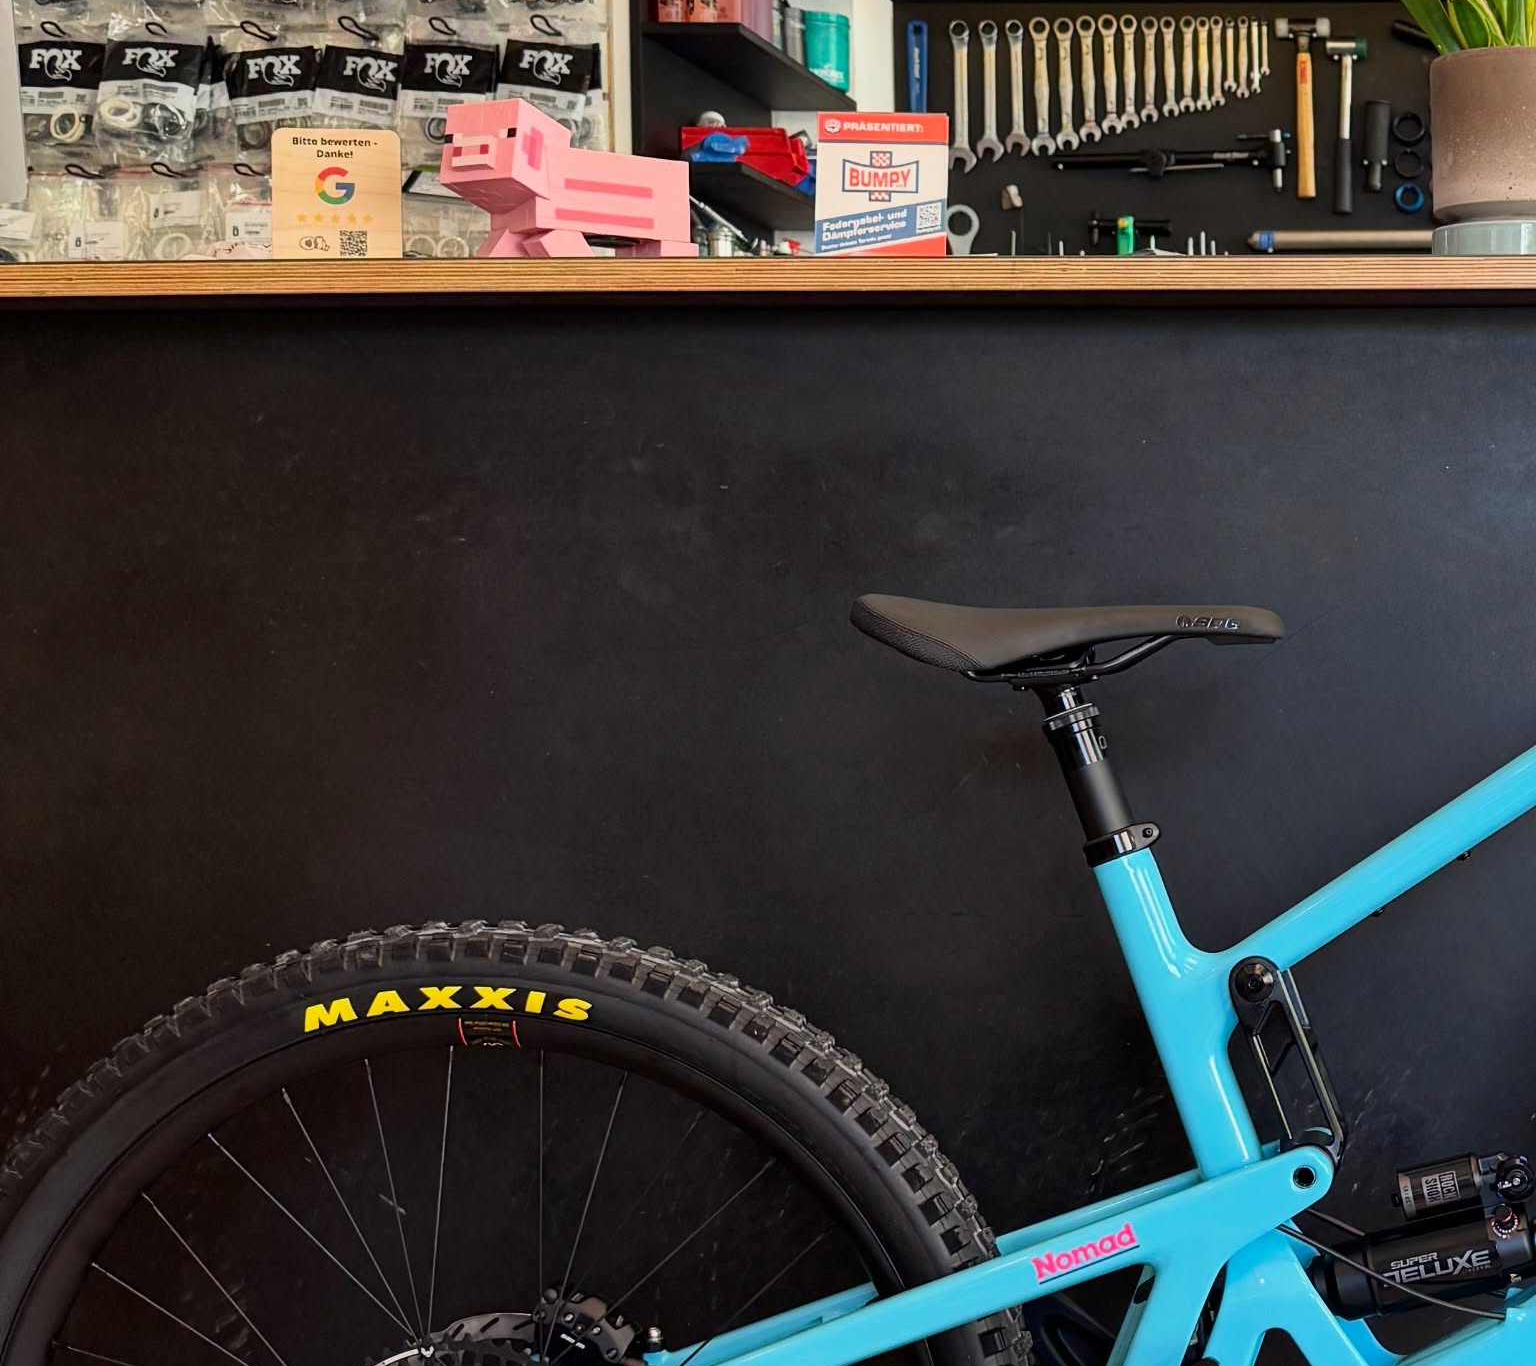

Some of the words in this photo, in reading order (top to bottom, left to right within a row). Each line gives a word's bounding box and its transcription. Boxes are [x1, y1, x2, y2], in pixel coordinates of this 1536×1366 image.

[29, 48, 82, 81] FOX
[122, 47, 179, 78] FOX
[246, 55, 301, 86] FOX
[343, 56, 398, 92] FOX
[424, 52, 472, 88] FOX
[520, 49, 574, 86] FOX
[292, 137, 316, 146] Bitte
[320, 137, 371, 146] bewerten
[843, 121, 925, 134] PRÄSENTIERT:
[316, 149, 354, 159] Danke!
[849, 167, 911, 188] BUMPY
[887, 209, 907, 221] und
[304, 986, 594, 1033] MAXXIS
[1031, 1222, 1138, 1280] Nomad
[1390, 1252, 1439, 1270] SUPER
